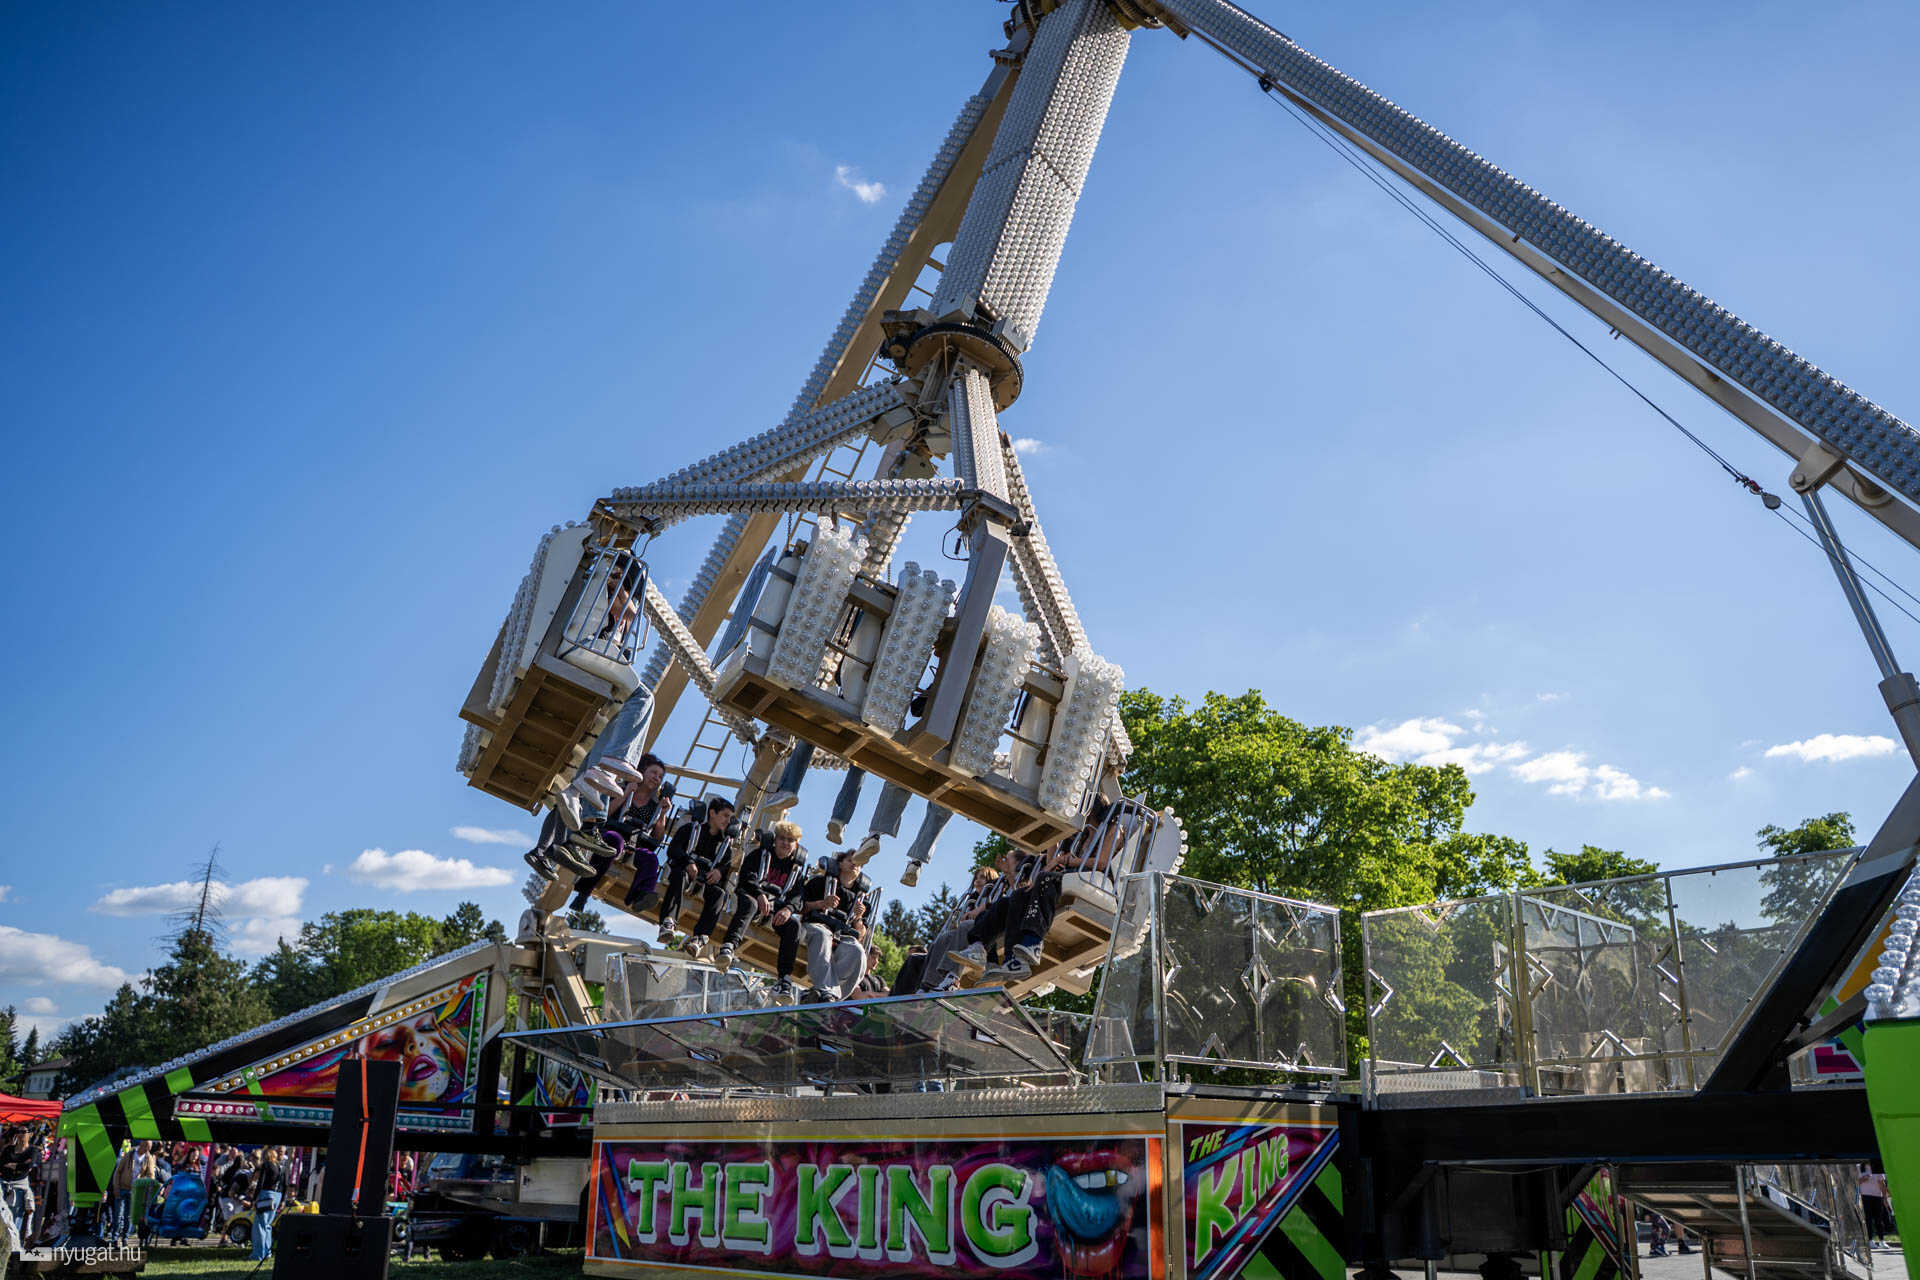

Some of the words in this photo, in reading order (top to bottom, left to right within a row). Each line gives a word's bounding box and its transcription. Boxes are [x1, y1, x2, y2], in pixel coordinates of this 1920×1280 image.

[1189, 1129, 1226, 1162] THE
[628, 1159, 773, 1255] THE
[795, 1163, 1039, 1268] KING
[1194, 1133, 1289, 1268] KING
